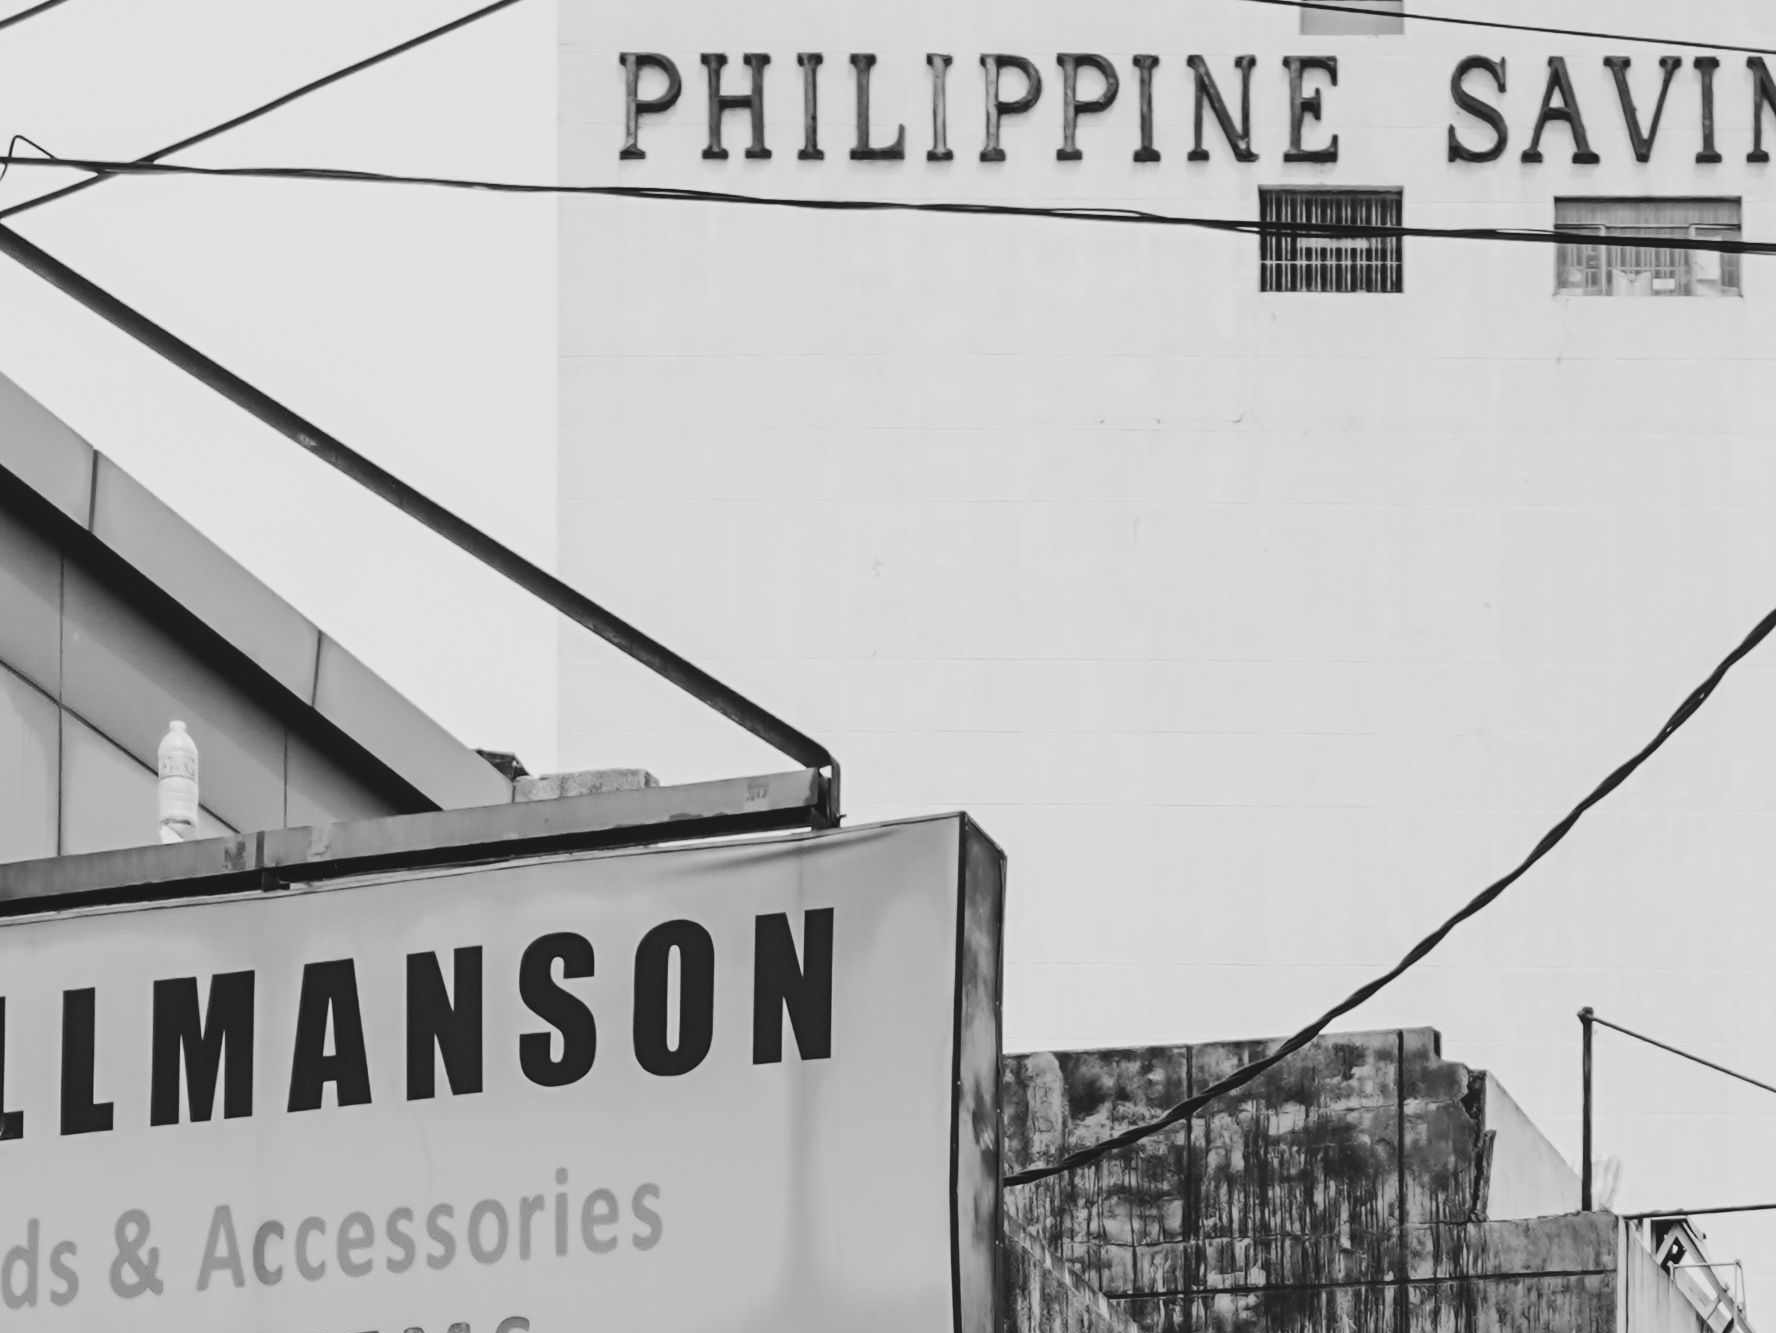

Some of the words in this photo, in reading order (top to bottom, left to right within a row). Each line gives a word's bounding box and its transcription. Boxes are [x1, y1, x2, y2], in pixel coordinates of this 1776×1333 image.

[619, 52, 1339, 163] PHILIPPINE
[109, 1209, 164, 1299] &
[196, 1167, 663, 1292] Accessories
